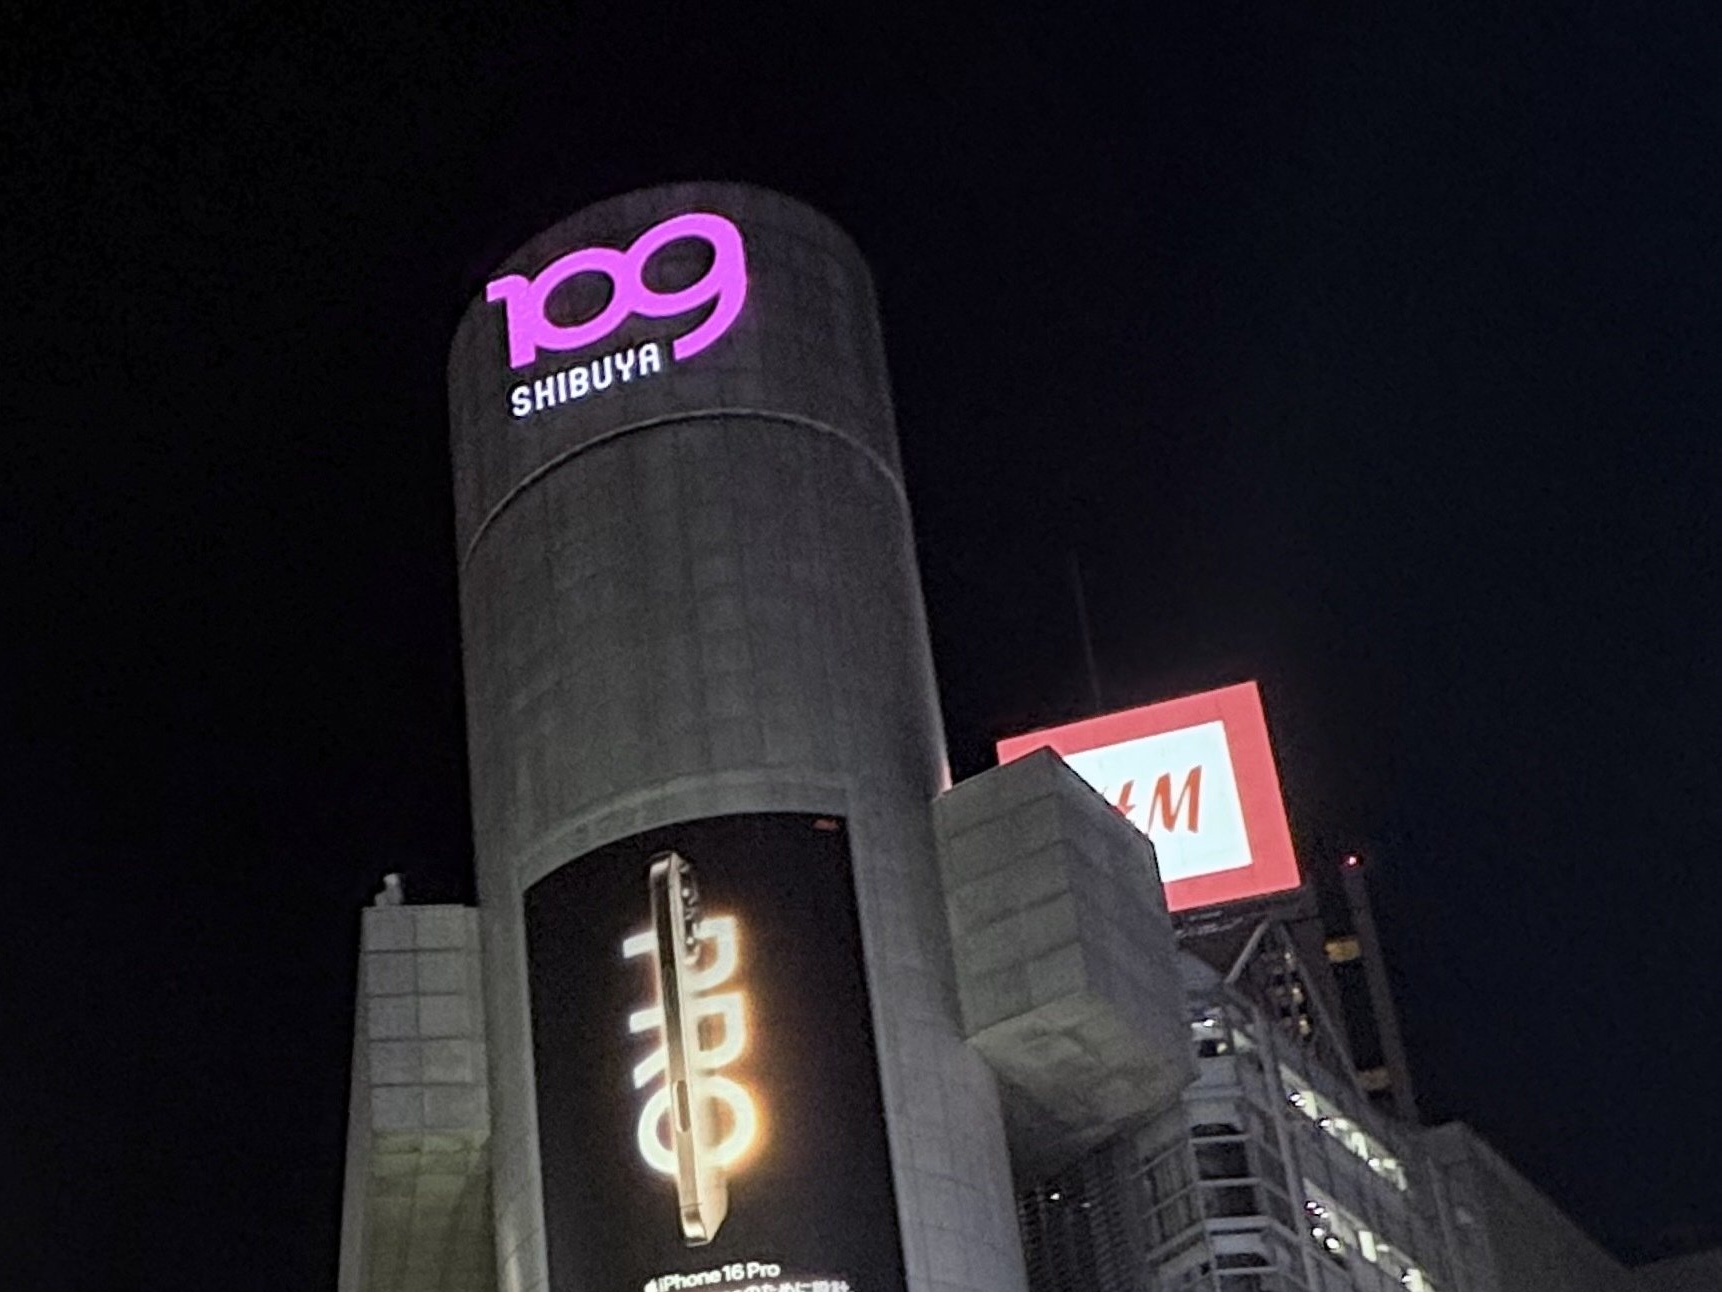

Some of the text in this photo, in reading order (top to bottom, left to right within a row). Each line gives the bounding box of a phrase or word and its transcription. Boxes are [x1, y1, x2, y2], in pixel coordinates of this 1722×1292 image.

[486, 212, 748, 369] 109
[511, 342, 661, 417] SHIBUYA
[723, 1265, 745, 1281] 16
[747, 1261, 781, 1279] Pro
